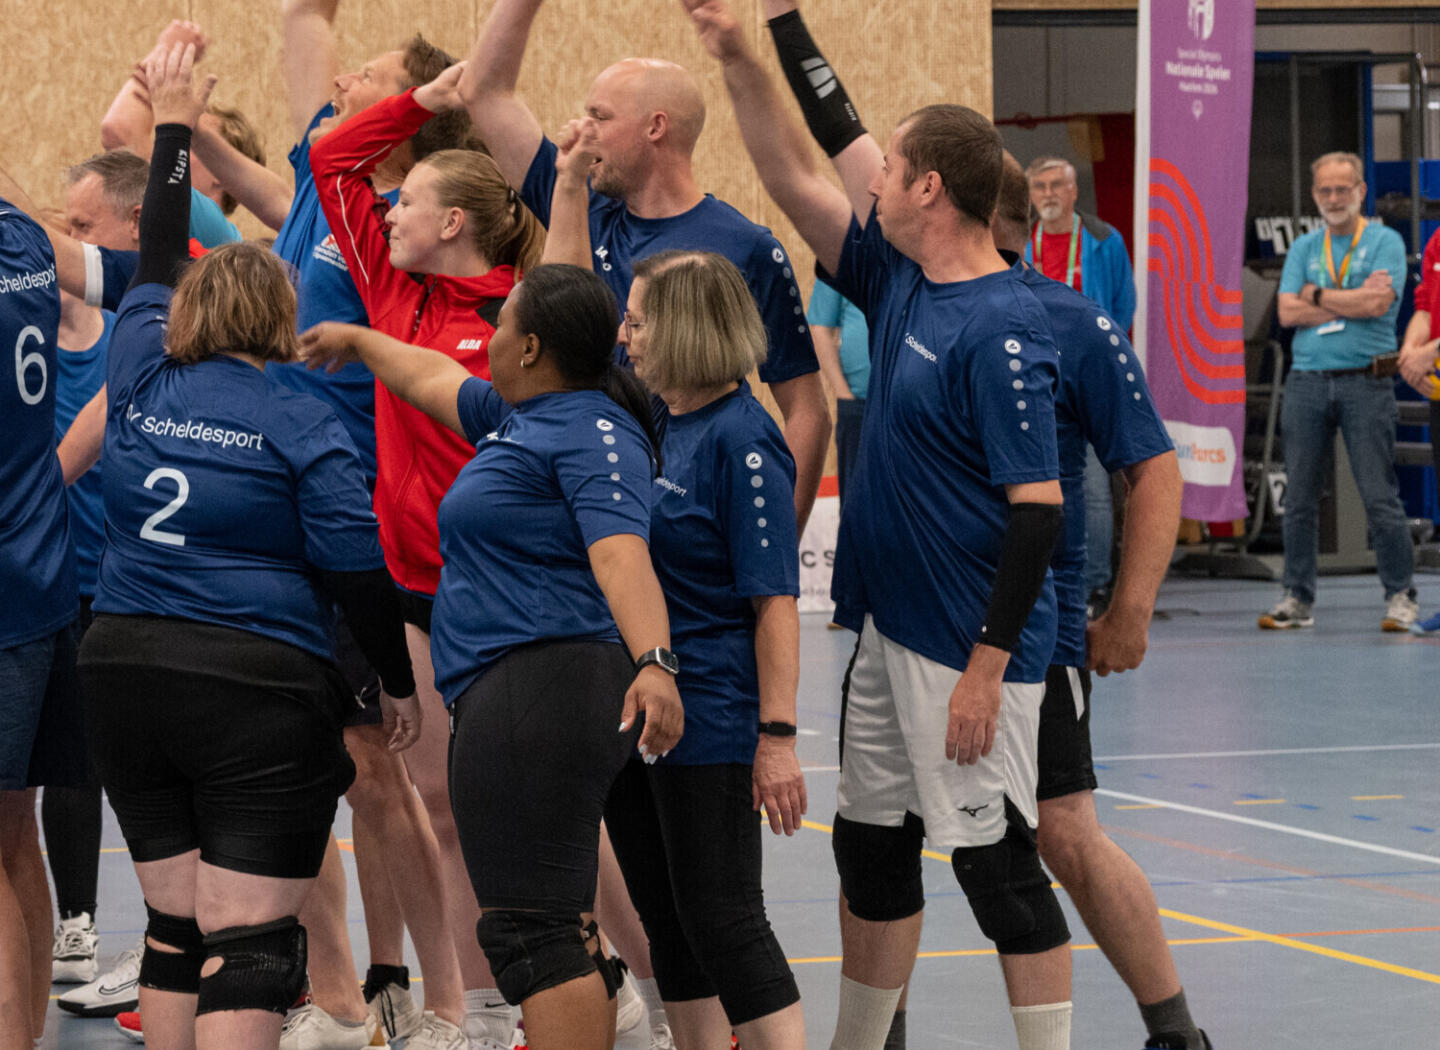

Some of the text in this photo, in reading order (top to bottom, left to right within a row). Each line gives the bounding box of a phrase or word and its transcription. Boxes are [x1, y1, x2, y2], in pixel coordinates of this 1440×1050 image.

[167, 149, 188, 184] KIPSTA
[14, 325, 48, 405] 6
[141, 416, 264, 451] Scheldesport
[140, 467, 190, 546] 2
